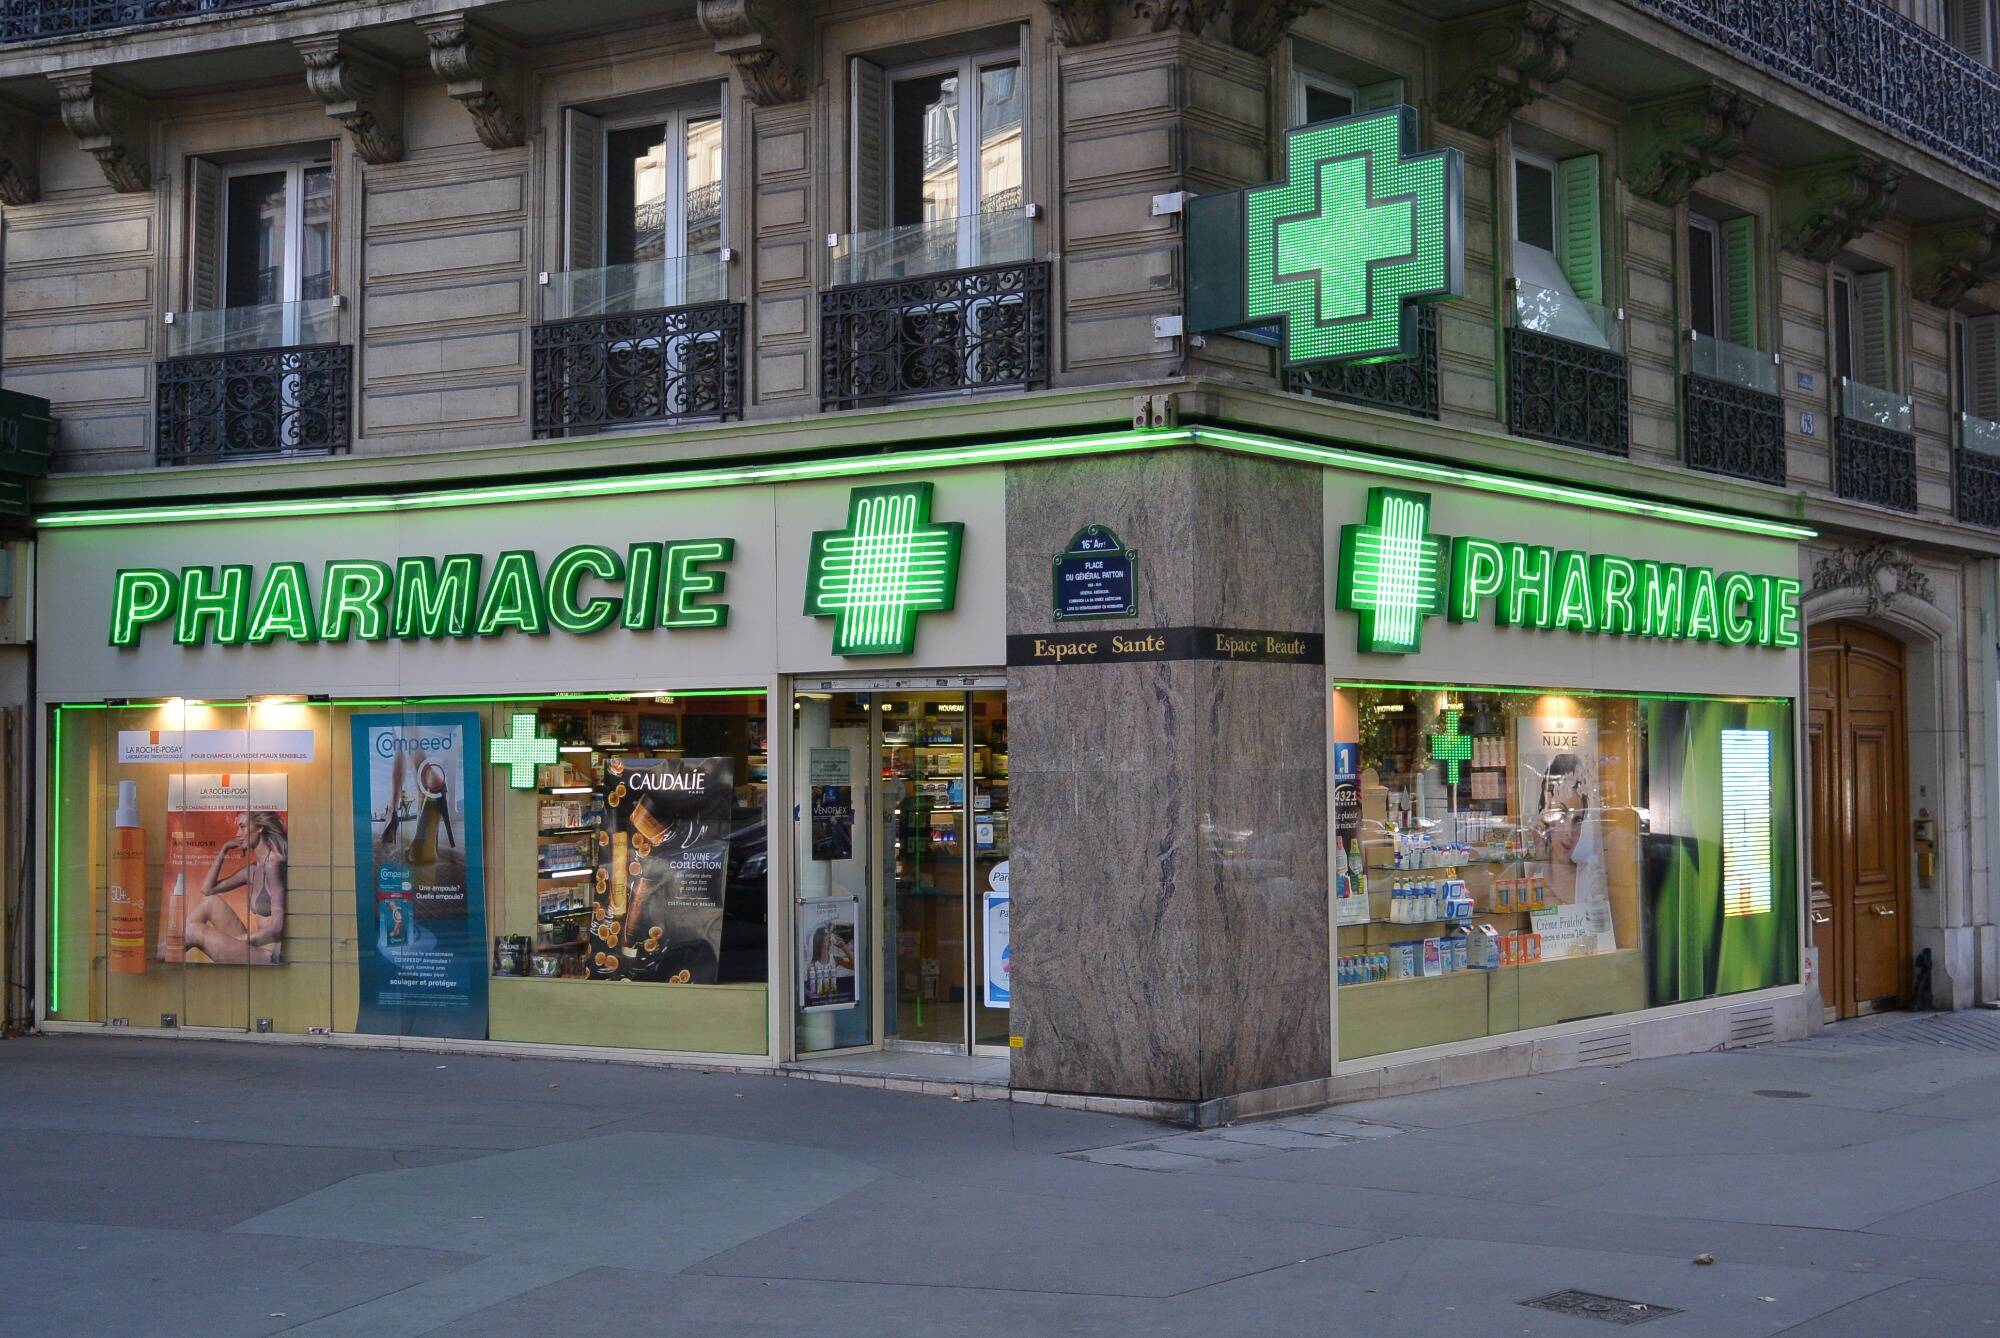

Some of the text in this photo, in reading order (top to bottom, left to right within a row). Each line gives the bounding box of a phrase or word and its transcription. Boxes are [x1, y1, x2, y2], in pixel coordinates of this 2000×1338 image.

[1801, 413, 1813, 434] 63
[1085, 561, 1104, 570] PLACE
[1075, 571, 1101, 580] GÉNÉRAL
[1102, 570, 1124, 579] PATTON
[108, 537, 735, 648] PHARMACIE
[1449, 536, 1801, 648] PHARMACIE
[1034, 635, 1165, 662] Espace Santé
[1216, 633, 1306, 658] Espace Beauté
[376, 731, 453, 759] Compeed
[1542, 735, 1578, 747] NUXE
[126, 746, 183, 754] LA ROCHE-POSAY
[1335, 790, 1357, 801] 4321
[813, 806, 847, 815] VENOFLEX
[683, 852, 711, 861] DIVINE
[669, 861, 722, 870] COLLECTION
[415, 892, 435, 900] Quelle
[1536, 917, 1557, 930] Crème
[390, 978, 418, 987] soulager
[428, 979, 457, 988] protéger
